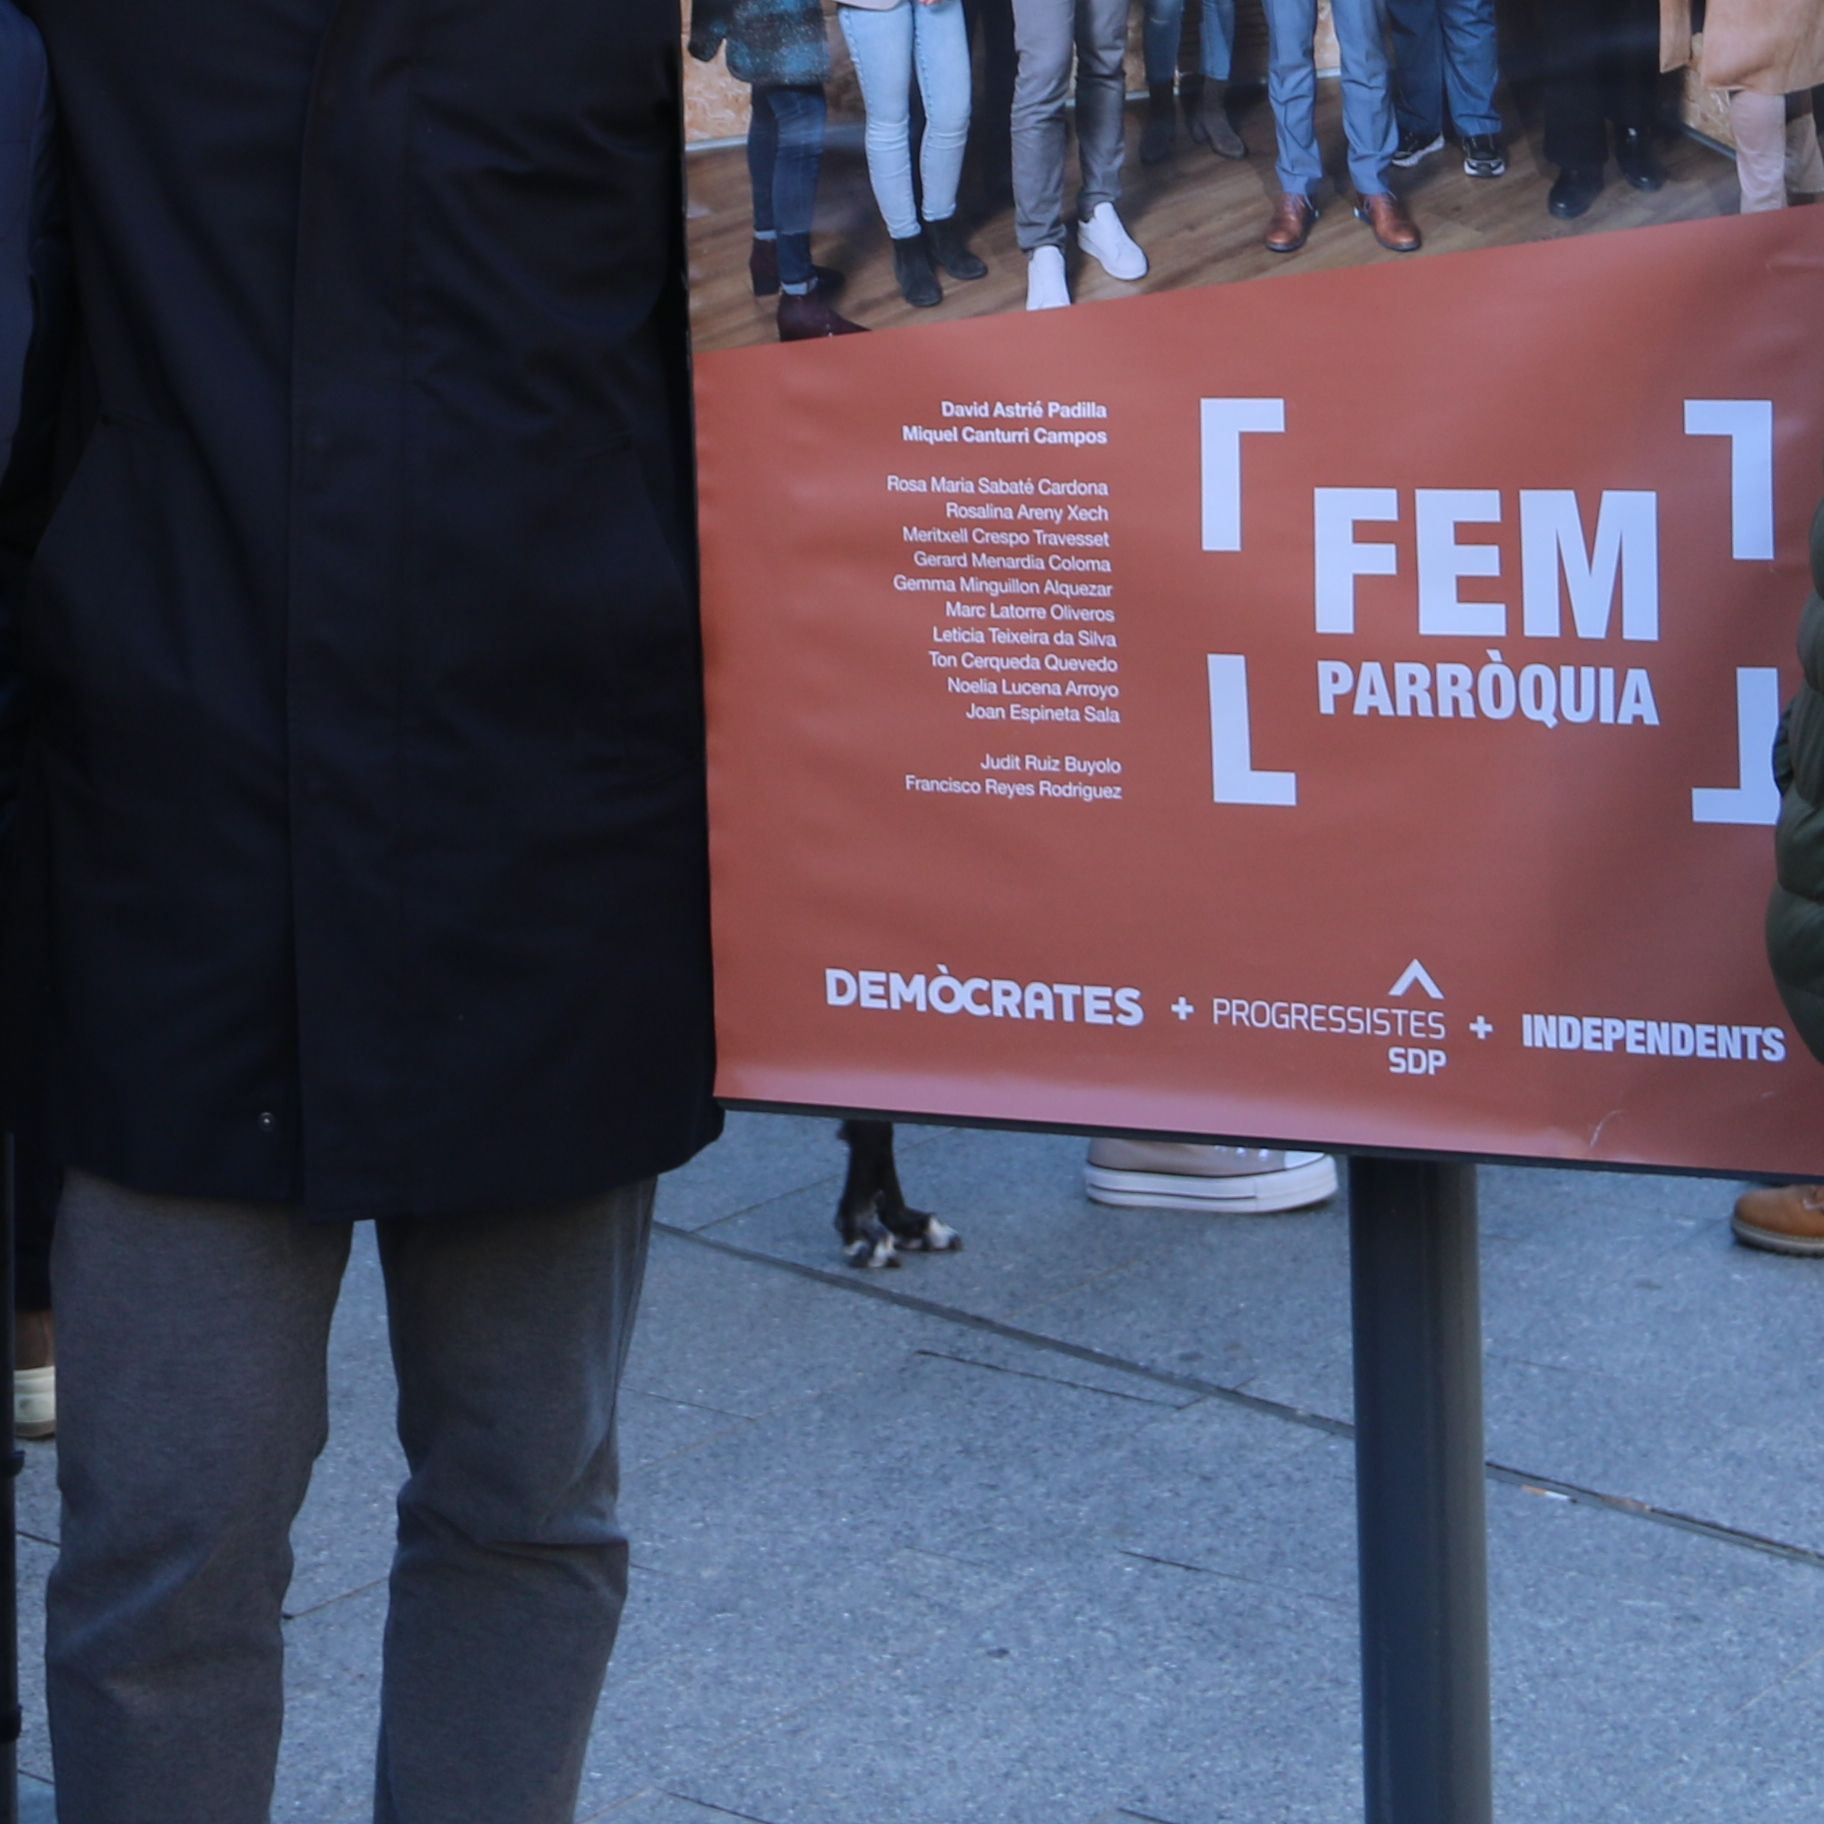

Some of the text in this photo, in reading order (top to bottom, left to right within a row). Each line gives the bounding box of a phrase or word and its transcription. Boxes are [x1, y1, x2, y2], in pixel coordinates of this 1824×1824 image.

[941, 400, 1107, 418] David Astrié Padilla
[902, 425, 1107, 447] Miquel Canturri Campos
[887, 475, 1108, 495] Rosa Maria Sabaté Cardona
[946, 502, 1108, 524] Rosalina Areny Xech
[903, 526, 1109, 547] Meritxell Crespo Travesset
[914, 550, 1111, 572] Gerard Menardia Coloma
[1314, 487, 1659, 642] FEM
[893, 574, 956, 592] Gemma
[1044, 579, 1113, 599] Alquezar
[946, 601, 1114, 622] Marc Latorre Oliveros
[933, 626, 1117, 648] Leticia Teixeira da Silva
[929, 651, 1118, 672] Ton Cerqueda Quevedo
[947, 677, 1119, 701] Noelia Lucena Arroyo
[1317, 649, 1660, 729] PARRÒQUIA
[966, 703, 1120, 724] Joan Espineta Sala
[980, 753, 1121, 776] Judit Ruiz Buyolo
[905, 775, 981, 794] Francisco
[985, 779, 1035, 799] Reyes
[824, 964, 1144, 1026] DEMÒCRATES
[1212, 997, 1446, 1041] PROGRESSISTES
[1522, 1013, 1786, 1062] INDEPENDENTS
[1388, 1046, 1447, 1076] SDP
